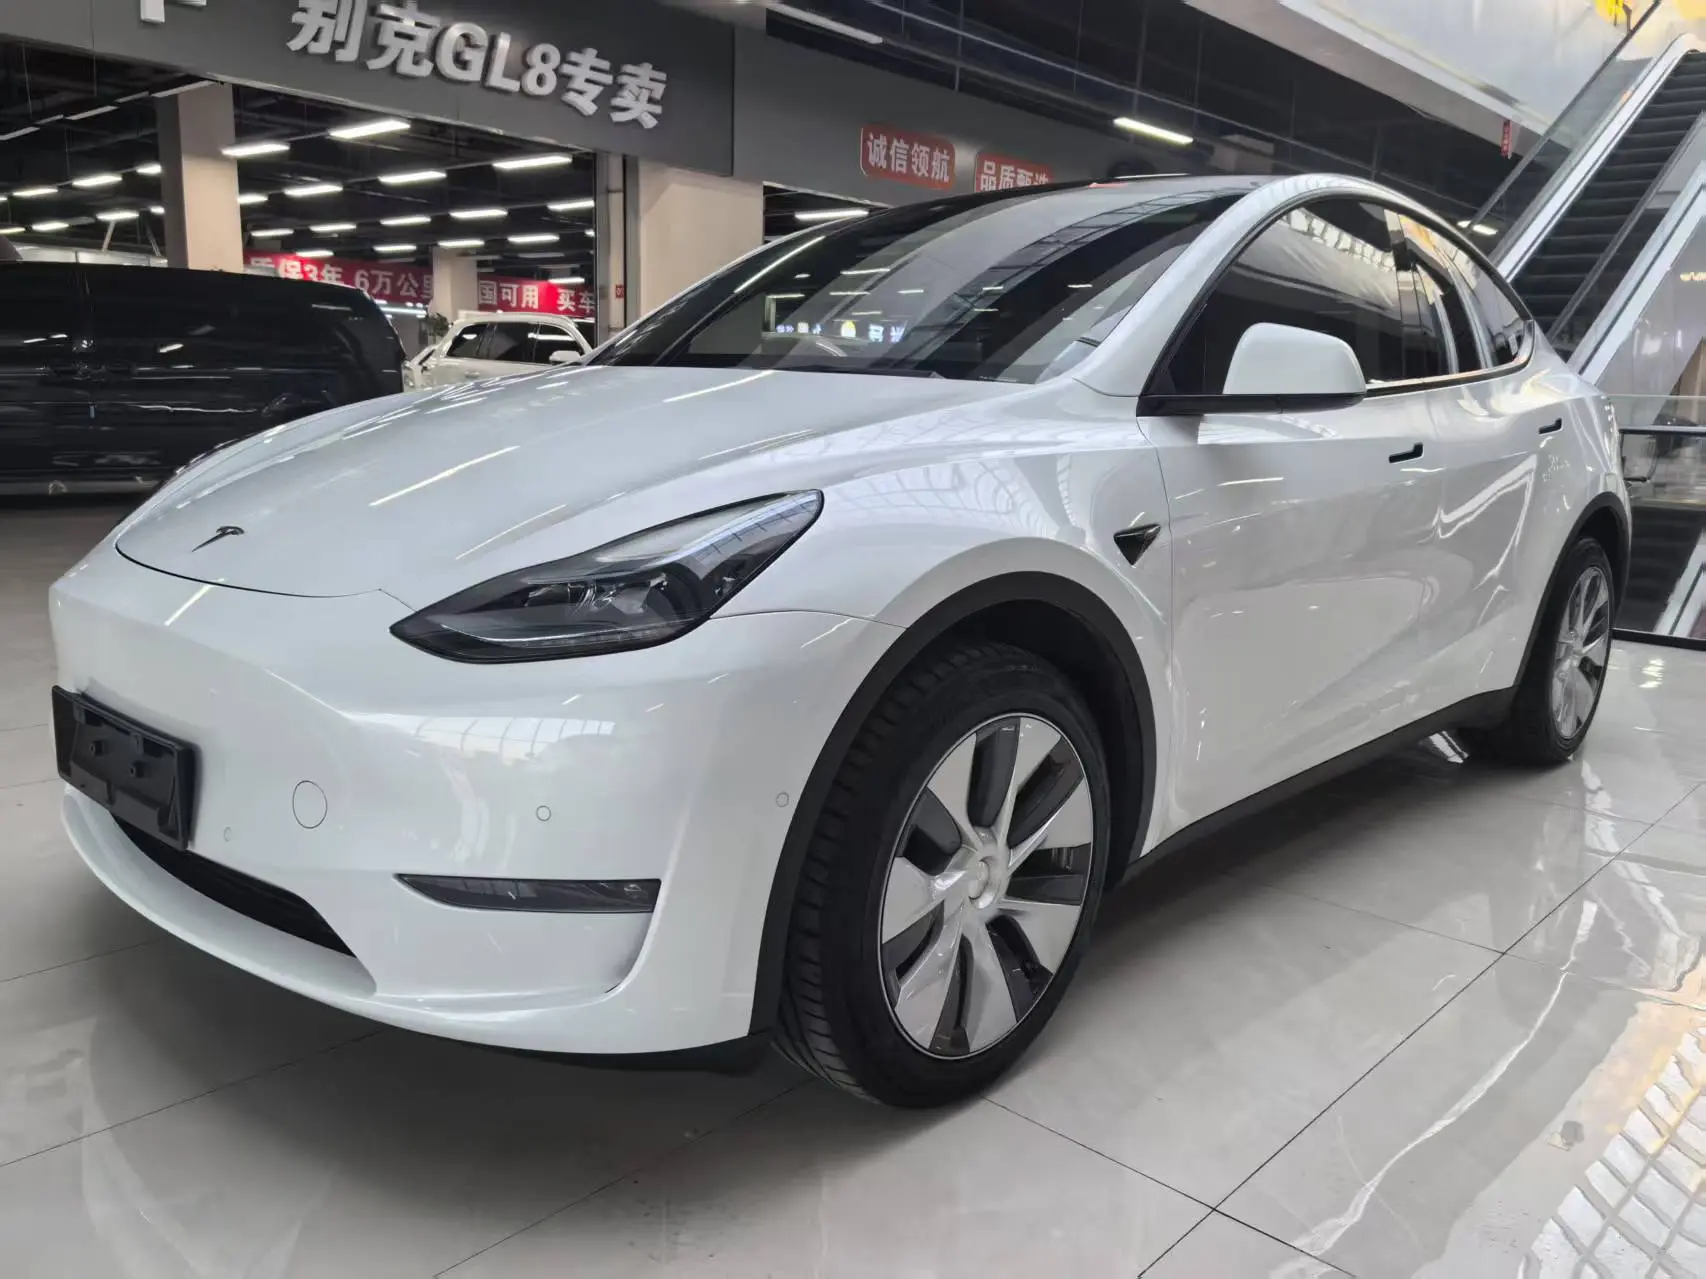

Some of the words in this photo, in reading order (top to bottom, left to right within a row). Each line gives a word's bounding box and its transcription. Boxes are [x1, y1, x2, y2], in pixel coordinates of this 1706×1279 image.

[287, 0, 667, 128] 别克GL8专卖
[867, 131, 950, 183] 诚信领航
